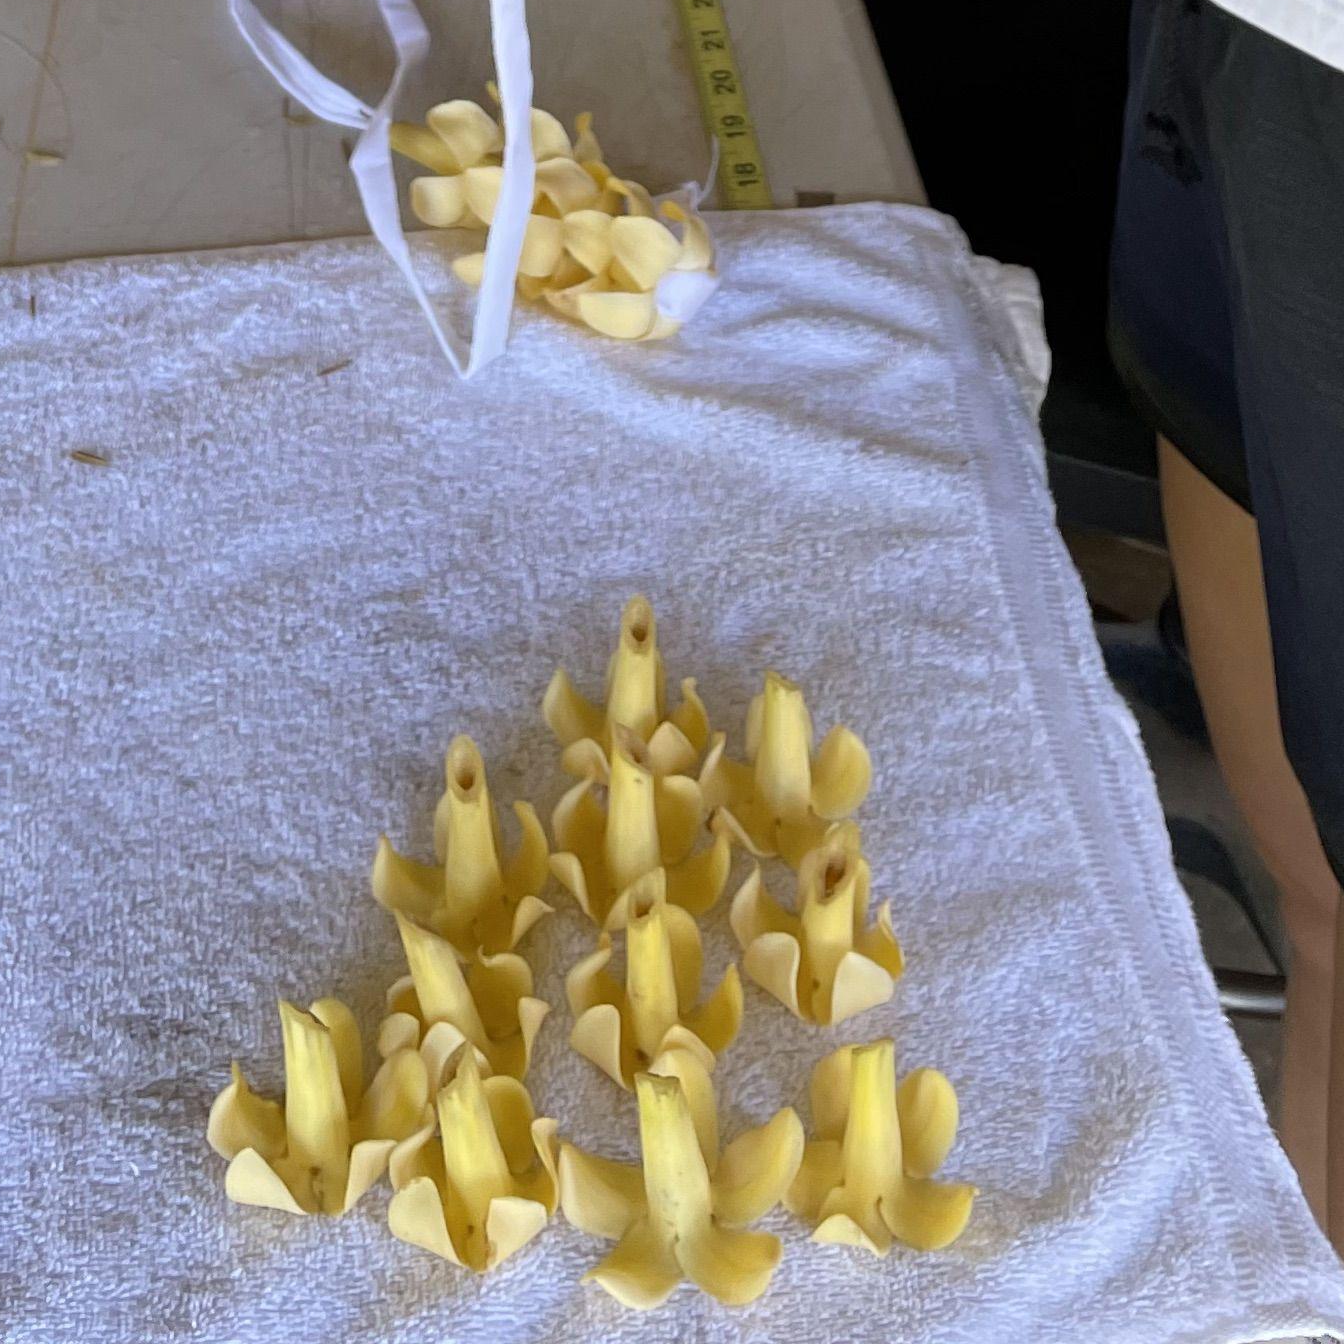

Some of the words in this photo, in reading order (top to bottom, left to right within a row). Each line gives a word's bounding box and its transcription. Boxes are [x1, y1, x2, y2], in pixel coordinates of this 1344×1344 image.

[700, 29, 725, 51] 21
[710, 69, 737, 95] 20
[721, 114, 746, 138] 19
[733, 161, 760, 187] 18
